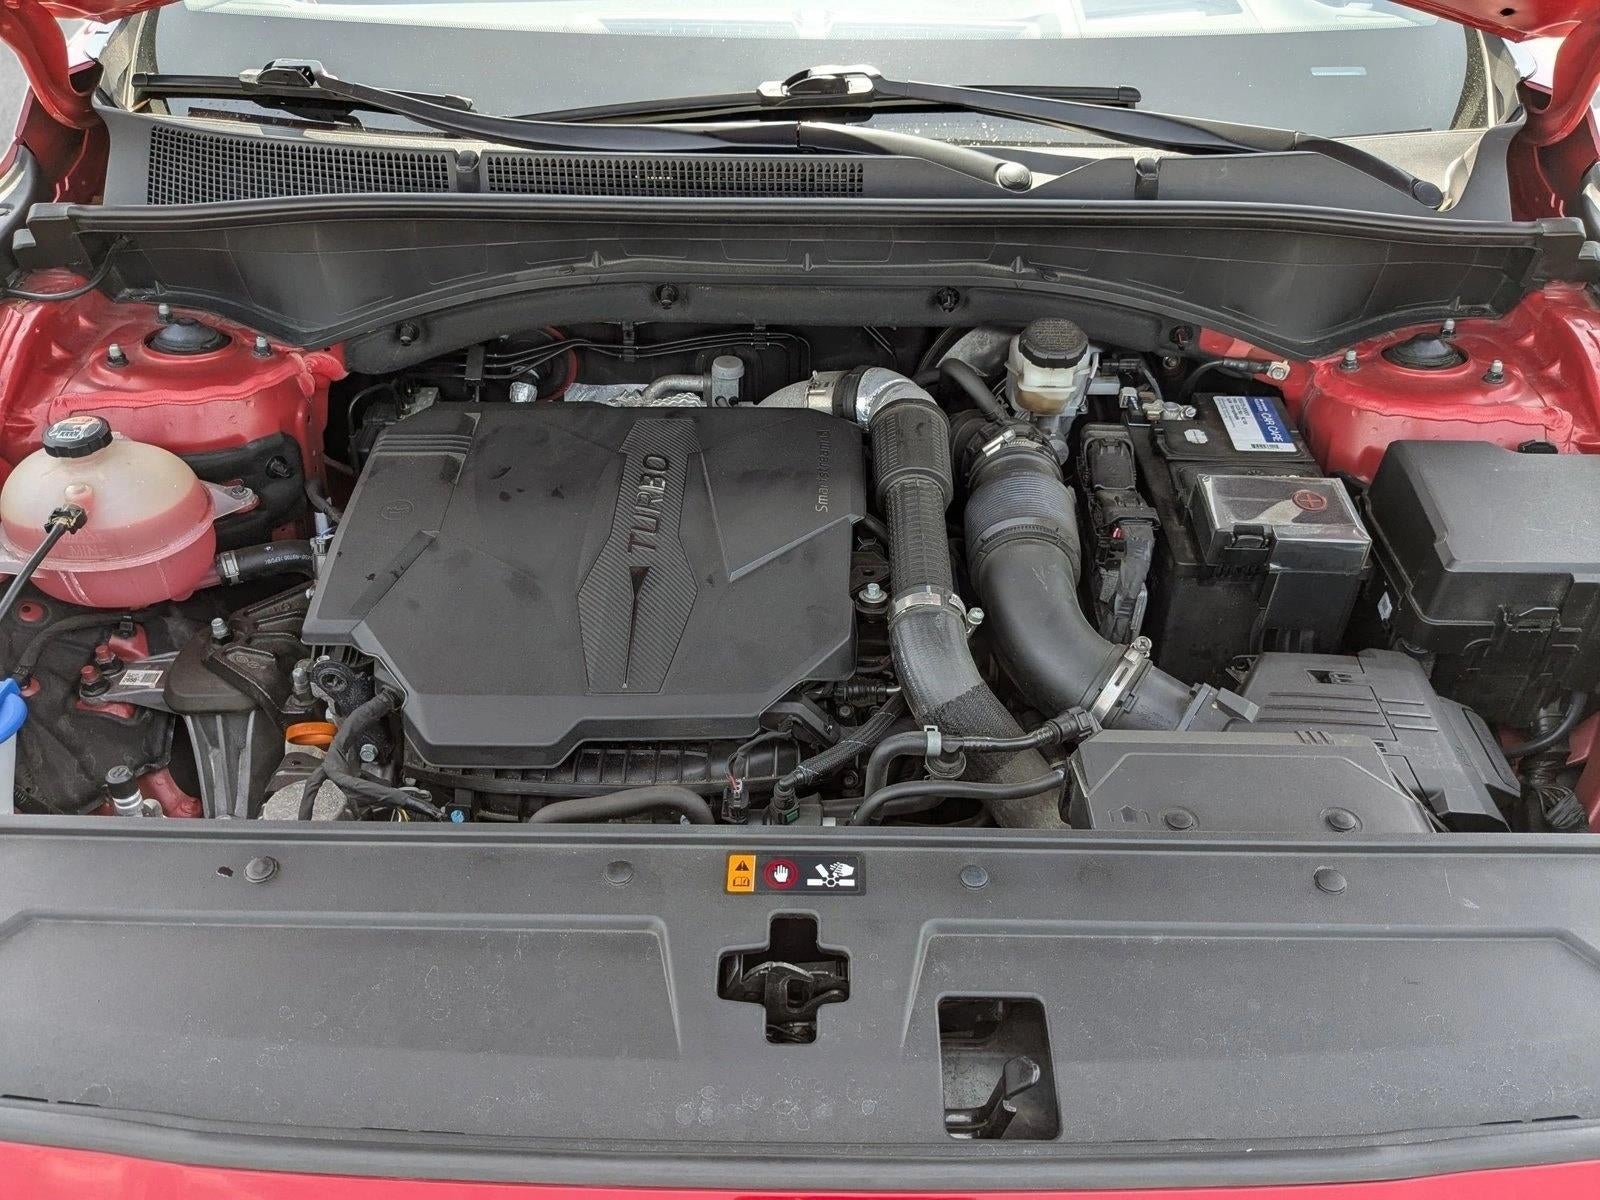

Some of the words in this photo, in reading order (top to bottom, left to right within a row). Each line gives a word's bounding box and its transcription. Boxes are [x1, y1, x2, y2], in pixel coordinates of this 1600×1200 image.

[1261, 412, 1275, 425] CAR
[1267, 426, 1284, 443] CARE
[627, 454, 669, 554] TURBO
